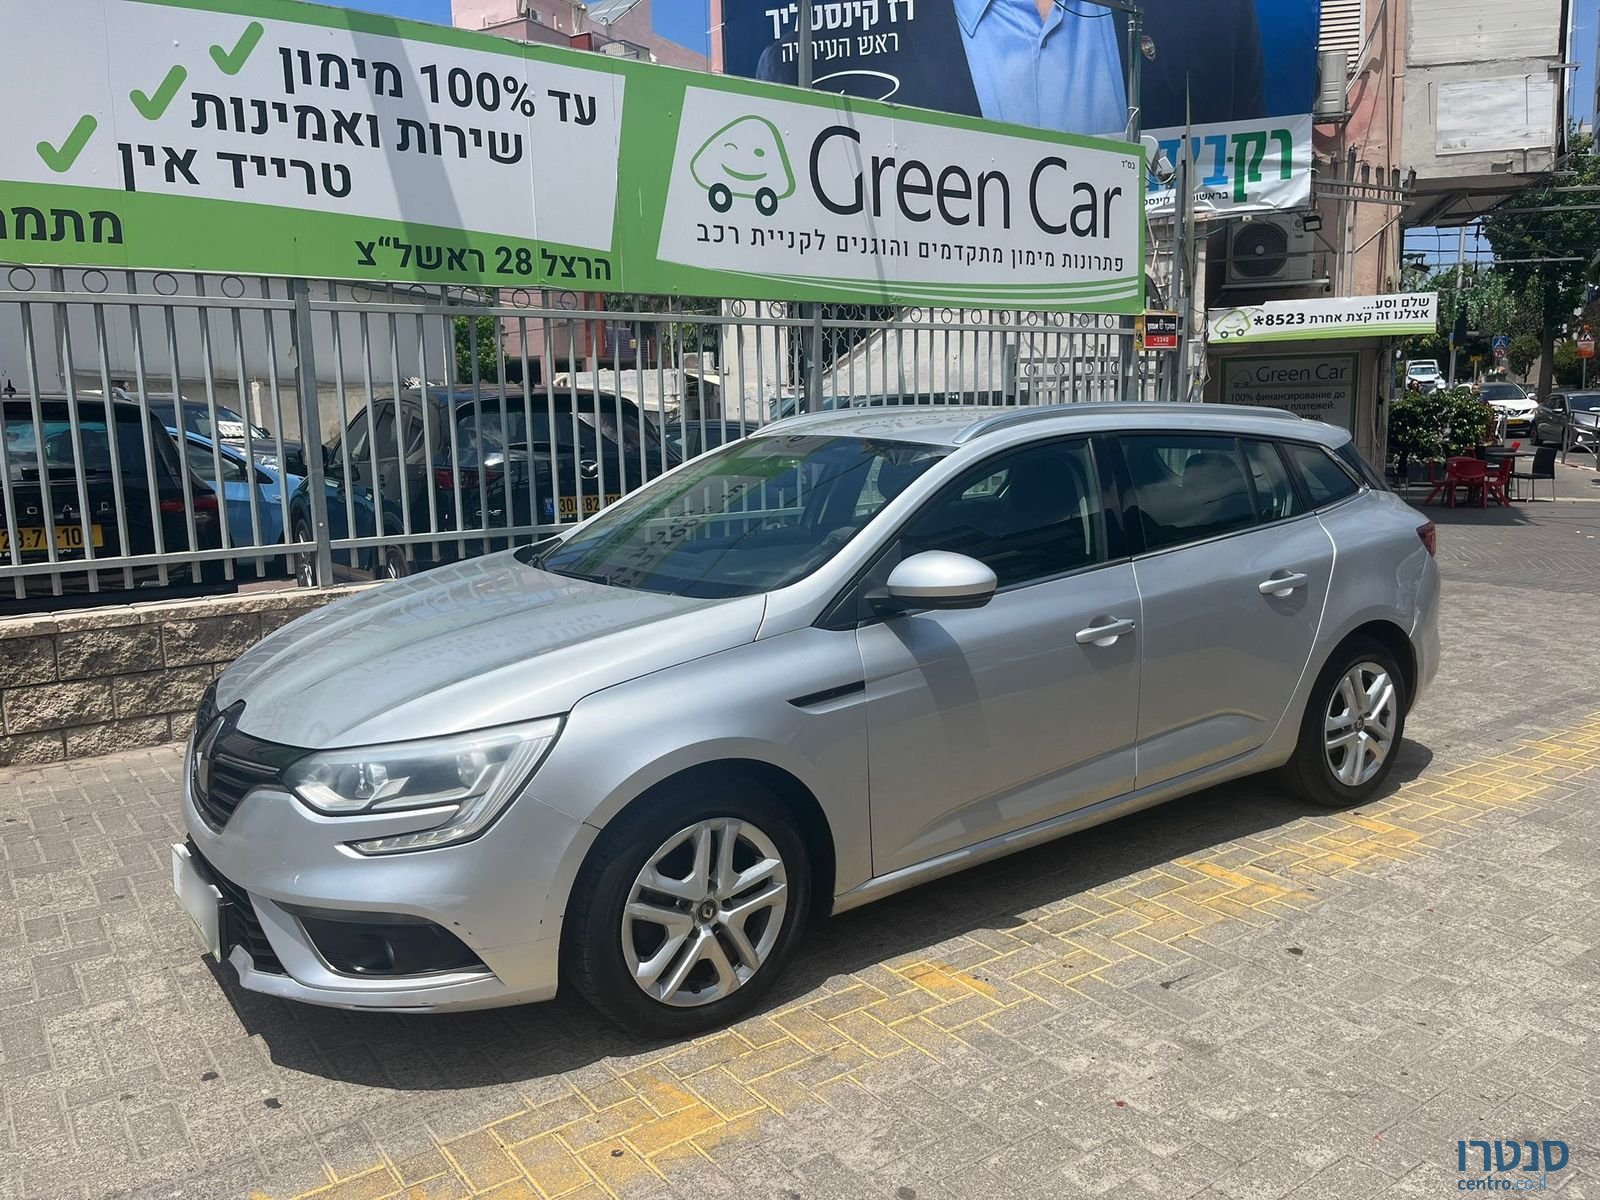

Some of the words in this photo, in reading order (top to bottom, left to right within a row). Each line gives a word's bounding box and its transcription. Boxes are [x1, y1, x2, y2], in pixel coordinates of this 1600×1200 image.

[857, 32, 899, 57] ראש
[278, 46, 404, 99] מימון
[420, 64, 536, 117] 100%
[191, 91, 381, 148] ואמינות
[546, 88, 597, 126] עד
[396, 118, 523, 165] שירות
[117, 142, 200, 192] אין
[216, 151, 352, 198] טרייד
[809, 125, 1011, 229] Green
[1029, 156, 1122, 239] Car
[696, 223, 739, 244] רכב
[750, 228, 826, 255] לקניית
[836, 235, 909, 257] והוגנים
[495, 246, 533, 275] 28
[541, 248, 611, 281] הרצל
[919, 241, 1003, 266] מתקדמים
[1011, 249, 1055, 269] מימון
[1062, 252, 1124, 272] פתרונות
[1394, 309, 1429, 320] אצלנו
[1401, 297, 1430, 307] שלם
[1308, 313, 1342, 324] אחרת
[1346, 312, 1372, 323] קצת
[1376, 312, 1391, 321] זה
[1256, 366, 1310, 382] Green
[1316, 363, 1347, 380] Car
